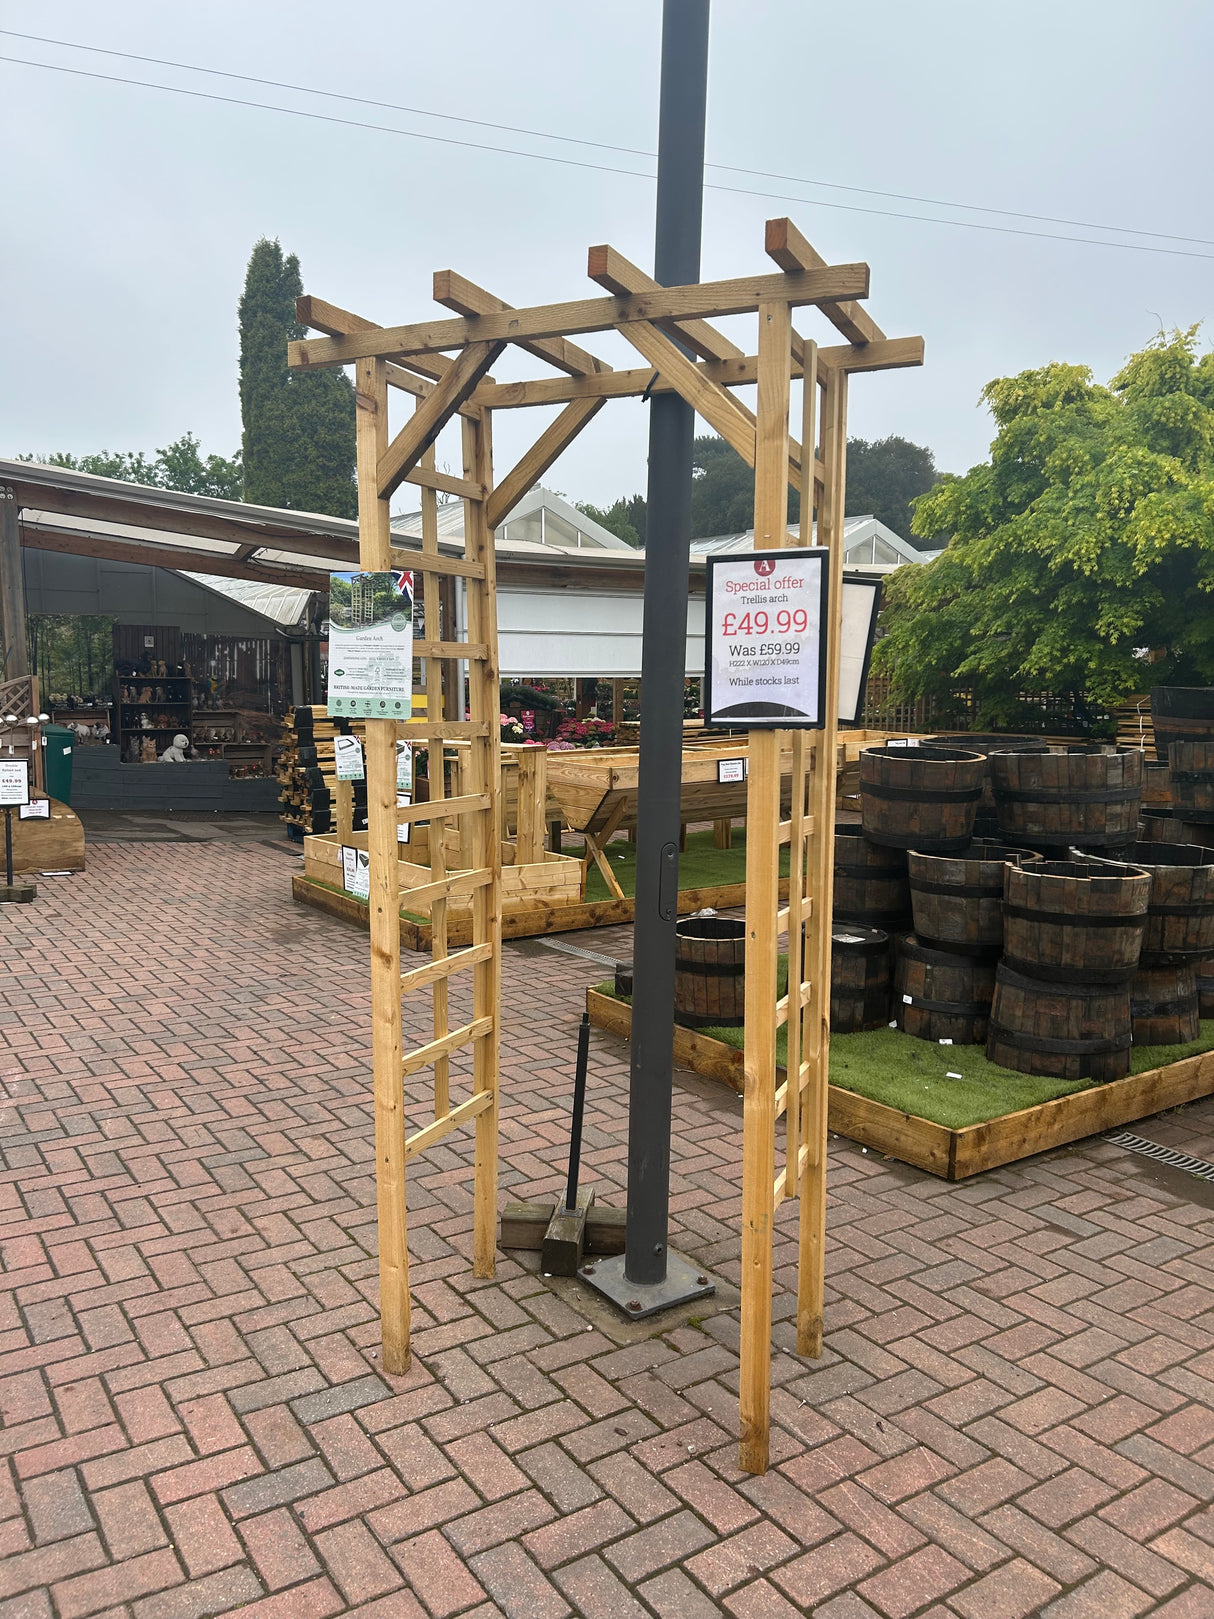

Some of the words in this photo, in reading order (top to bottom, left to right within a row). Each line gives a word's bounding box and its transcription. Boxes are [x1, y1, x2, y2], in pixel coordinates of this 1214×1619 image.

[725, 578, 771, 595] Special
[774, 576, 804, 590] offer
[740, 595, 768, 604] Trellis
[768, 594, 789, 603] arch
[722, 609, 808, 636] £49.99
[729, 644, 757, 657] Was
[759, 642, 800, 656] £59.99
[729, 677, 754, 686] While
[755, 676, 783, 686] stocks
[783, 675, 800, 685] last
